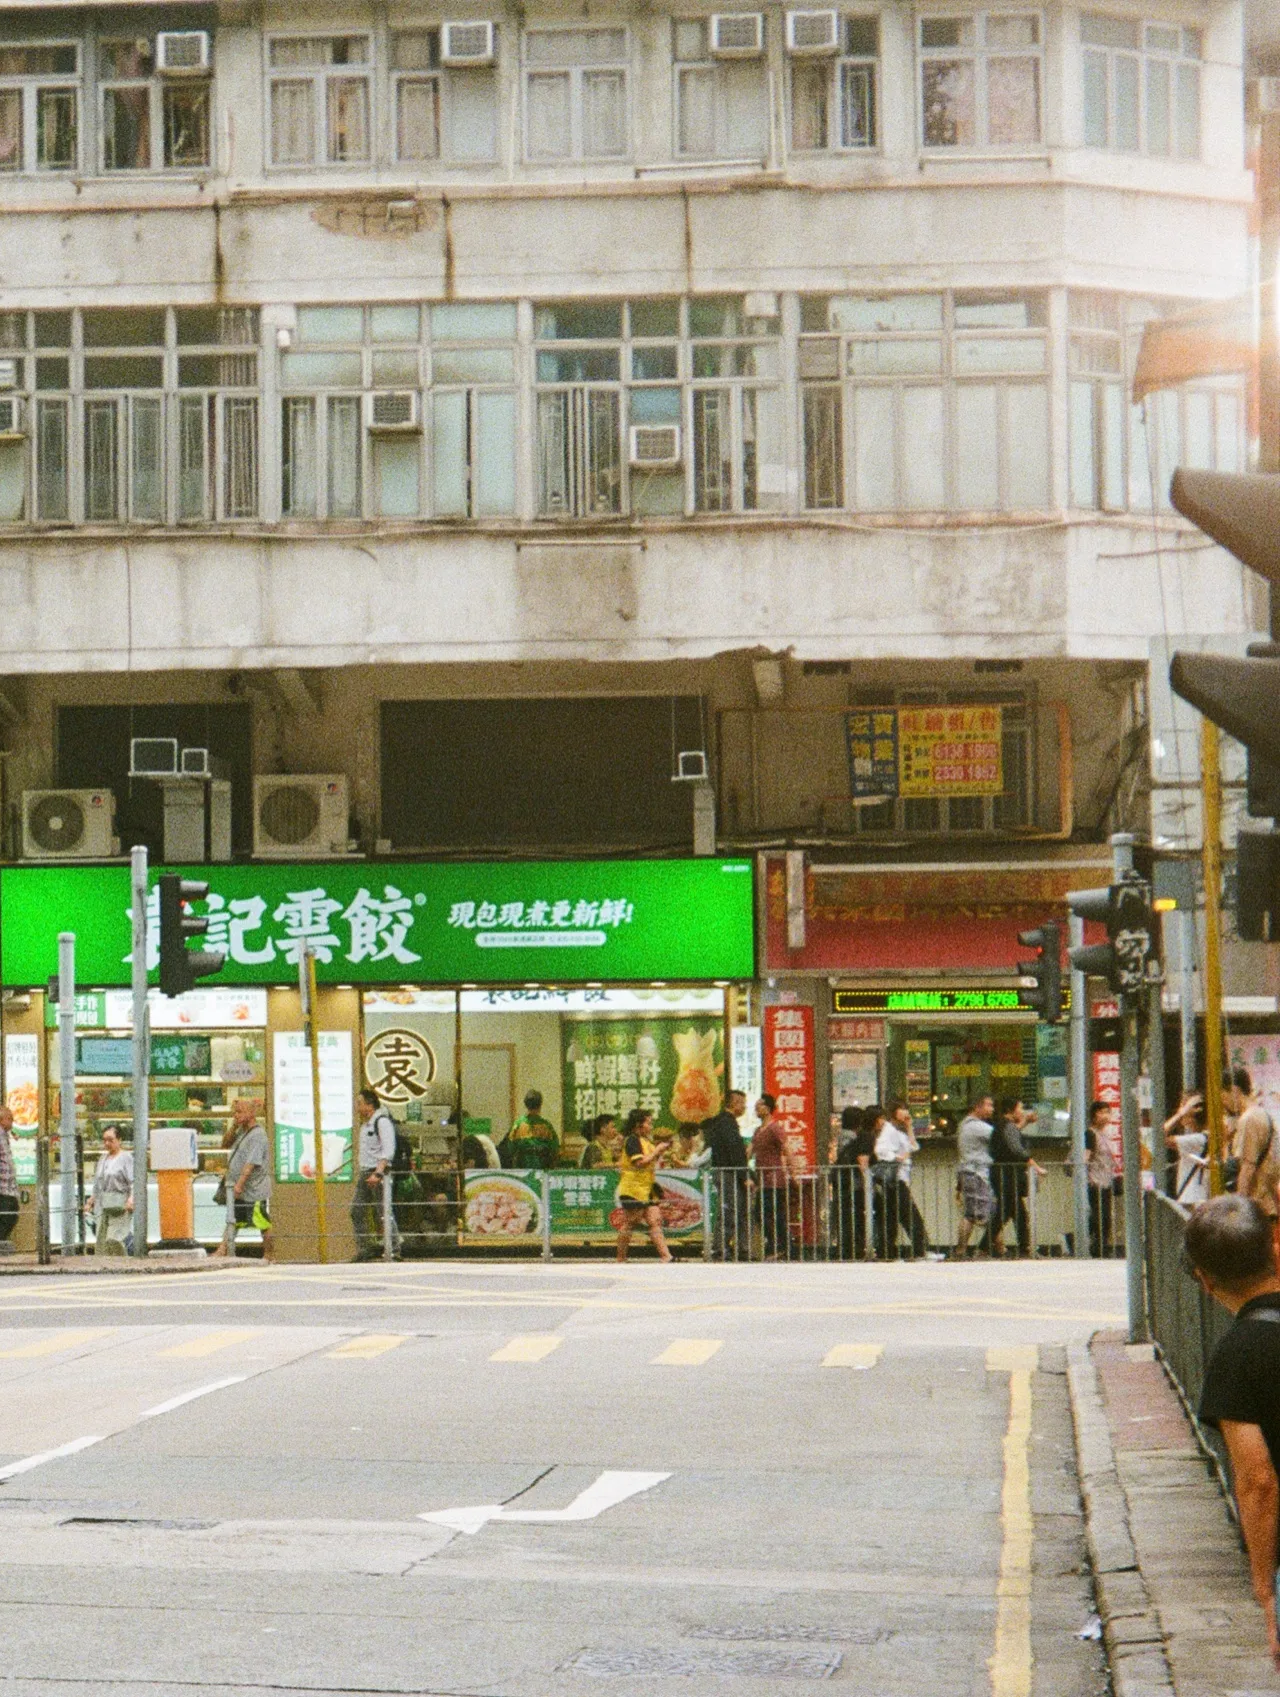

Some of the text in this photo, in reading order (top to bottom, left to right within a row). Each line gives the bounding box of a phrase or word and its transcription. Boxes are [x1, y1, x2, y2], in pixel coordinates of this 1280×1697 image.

[447, 898, 634, 928] 現包現煮更新鮮!
[372, 1036, 428, 1097] 袁
